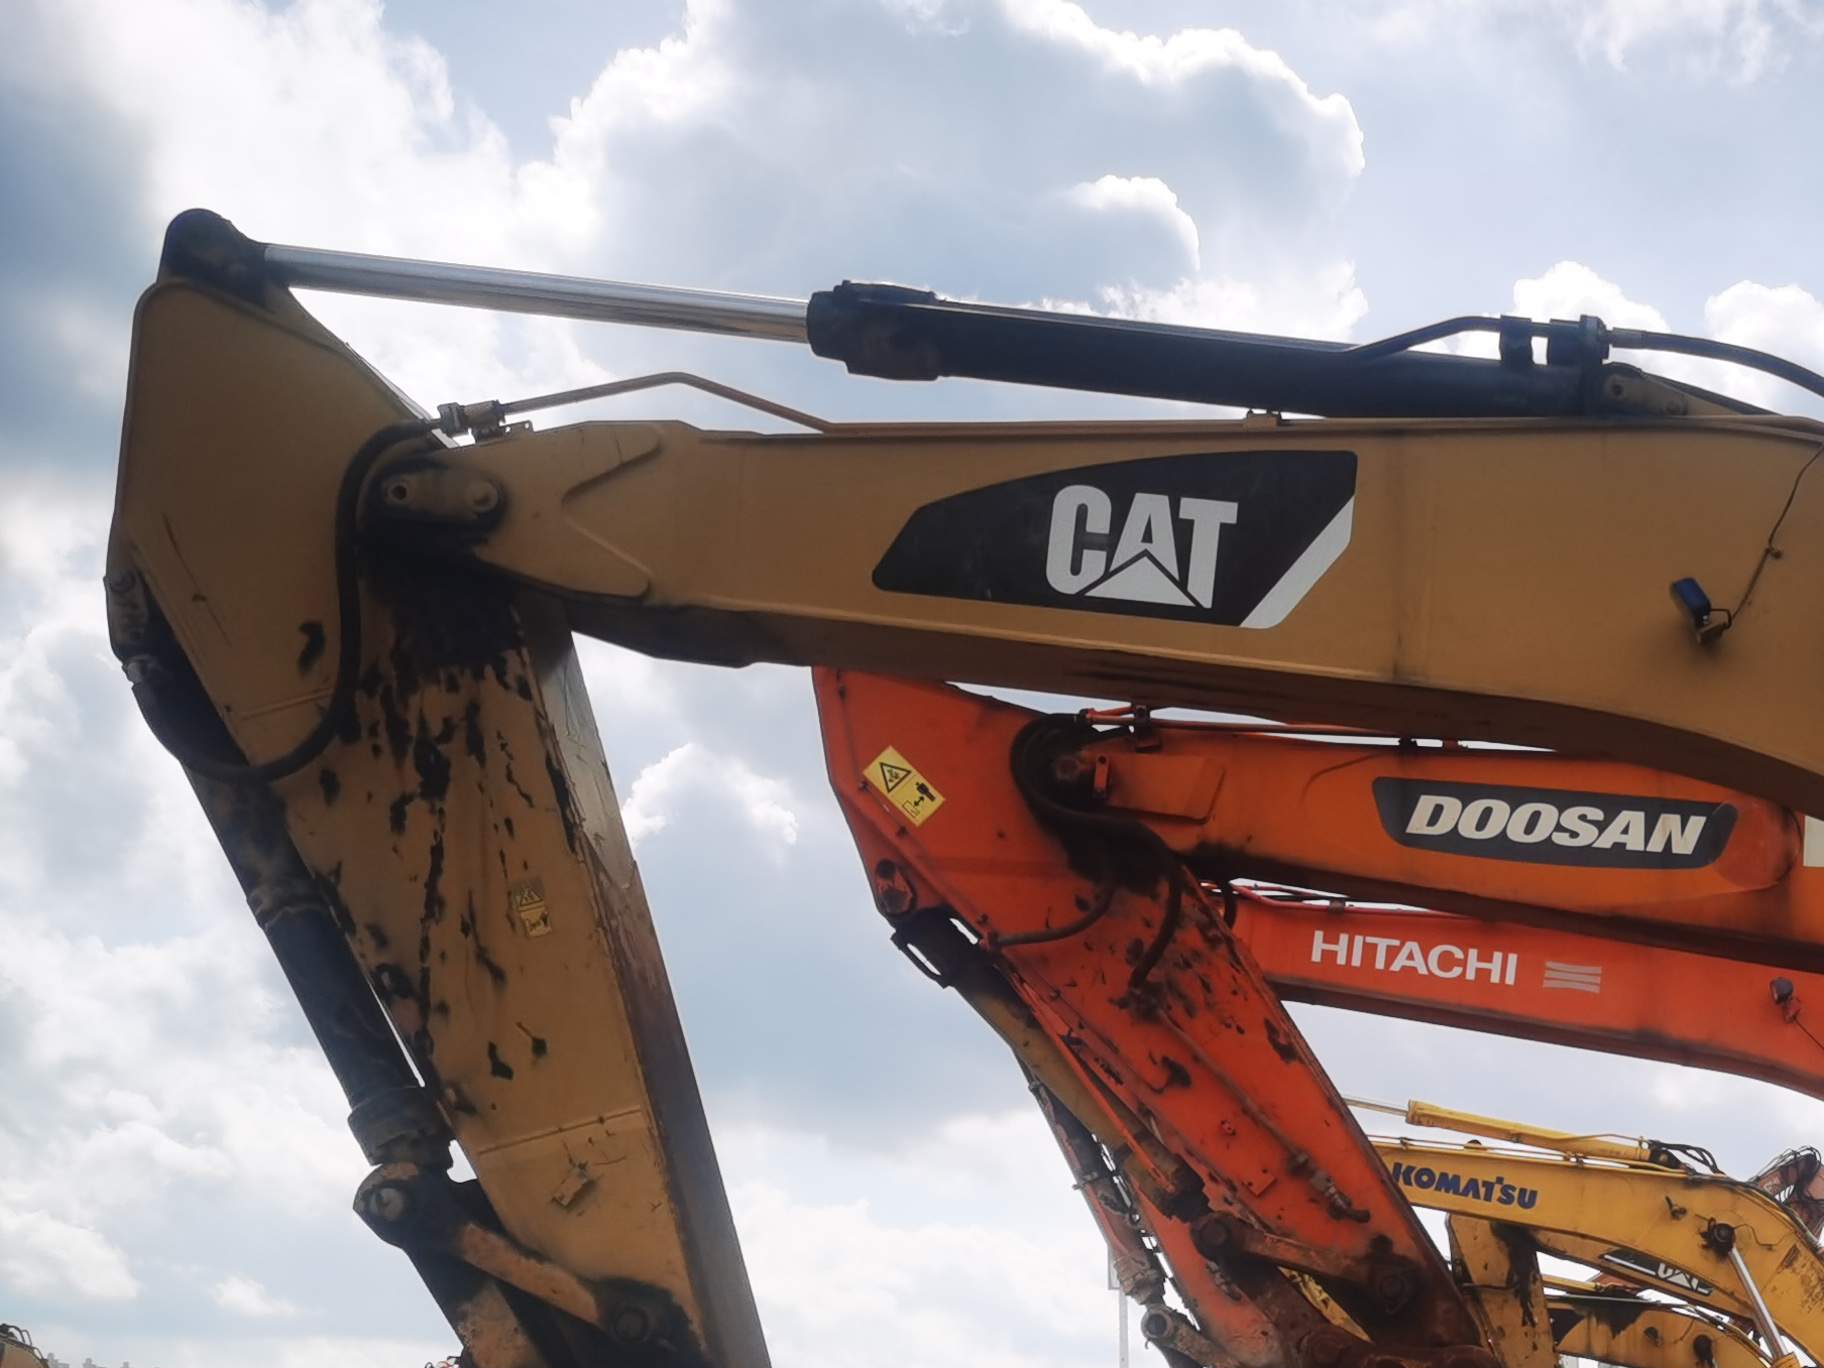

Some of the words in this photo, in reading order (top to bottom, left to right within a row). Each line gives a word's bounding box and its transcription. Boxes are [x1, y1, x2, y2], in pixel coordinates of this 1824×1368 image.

[1046, 484, 1239, 609] CAT
[1405, 794, 1707, 855] DOOSAN
[1311, 930, 1519, 986] HITACHI
[1392, 1161, 1538, 1210] KOMATSU
